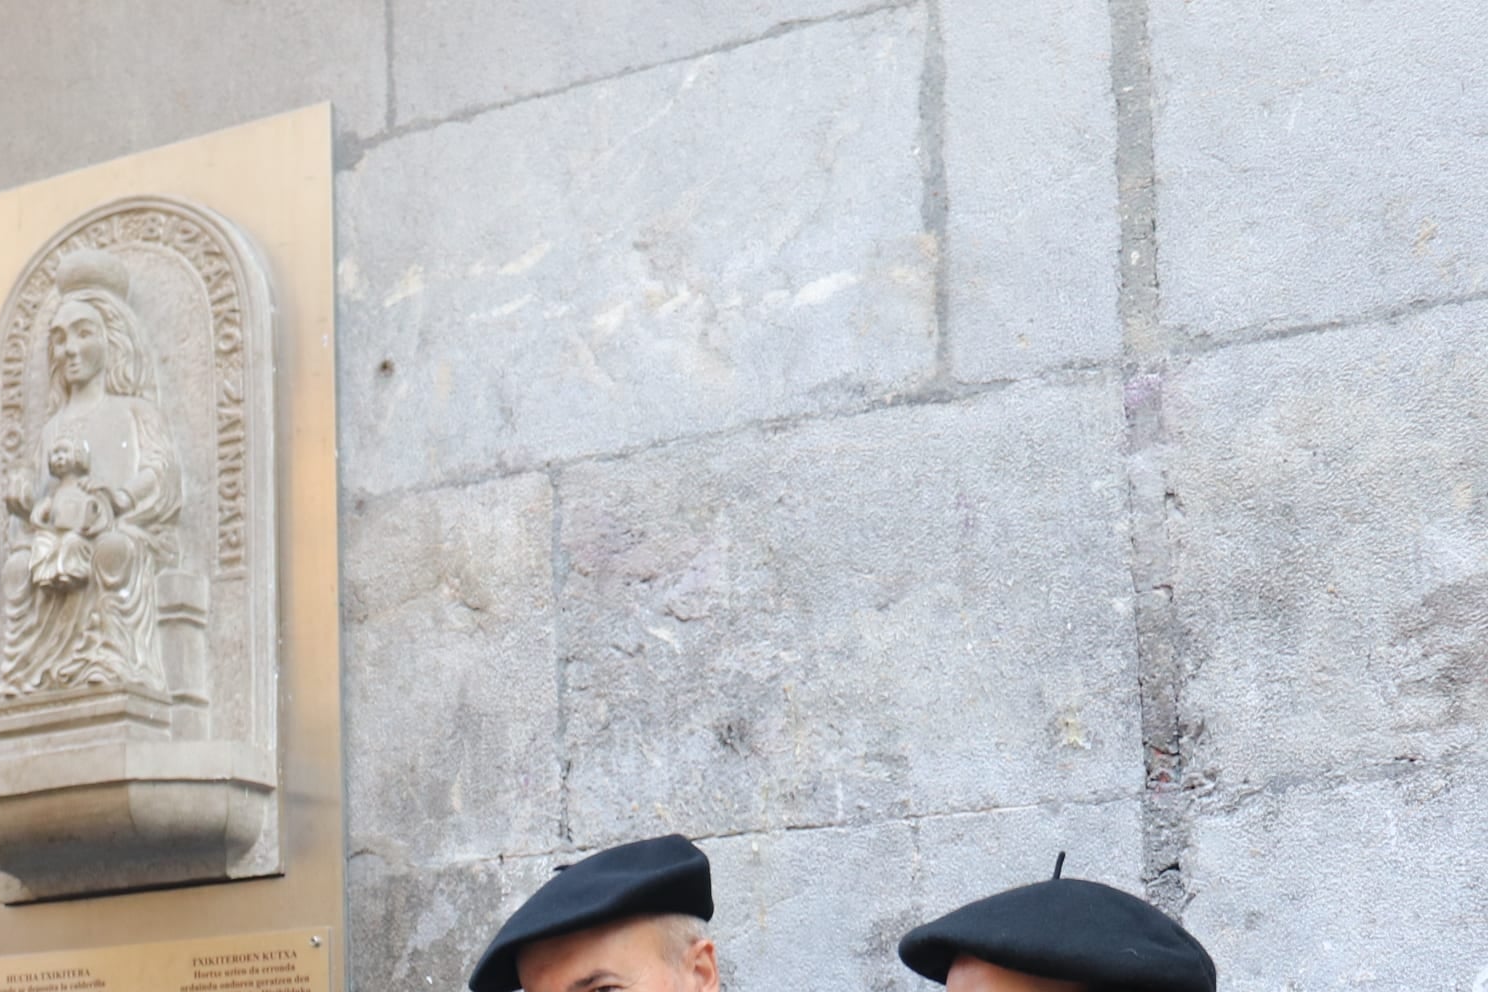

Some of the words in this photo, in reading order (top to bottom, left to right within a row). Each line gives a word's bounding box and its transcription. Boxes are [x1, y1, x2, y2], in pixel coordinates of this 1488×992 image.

[193, 952, 259, 967] TXIKITEROEN
[263, 950, 297, 960] KUTXA
[6, 973, 38, 984] HUCHA
[41, 968, 90, 980] TXIKITERA
[249, 966, 259, 975] da
[262, 963, 295, 974] erronda
[180, 983, 217, 992] ordaindu
[220, 980, 253, 989] ondoren
[256, 977, 292, 989] geratzen
[294, 975, 310, 983] den
